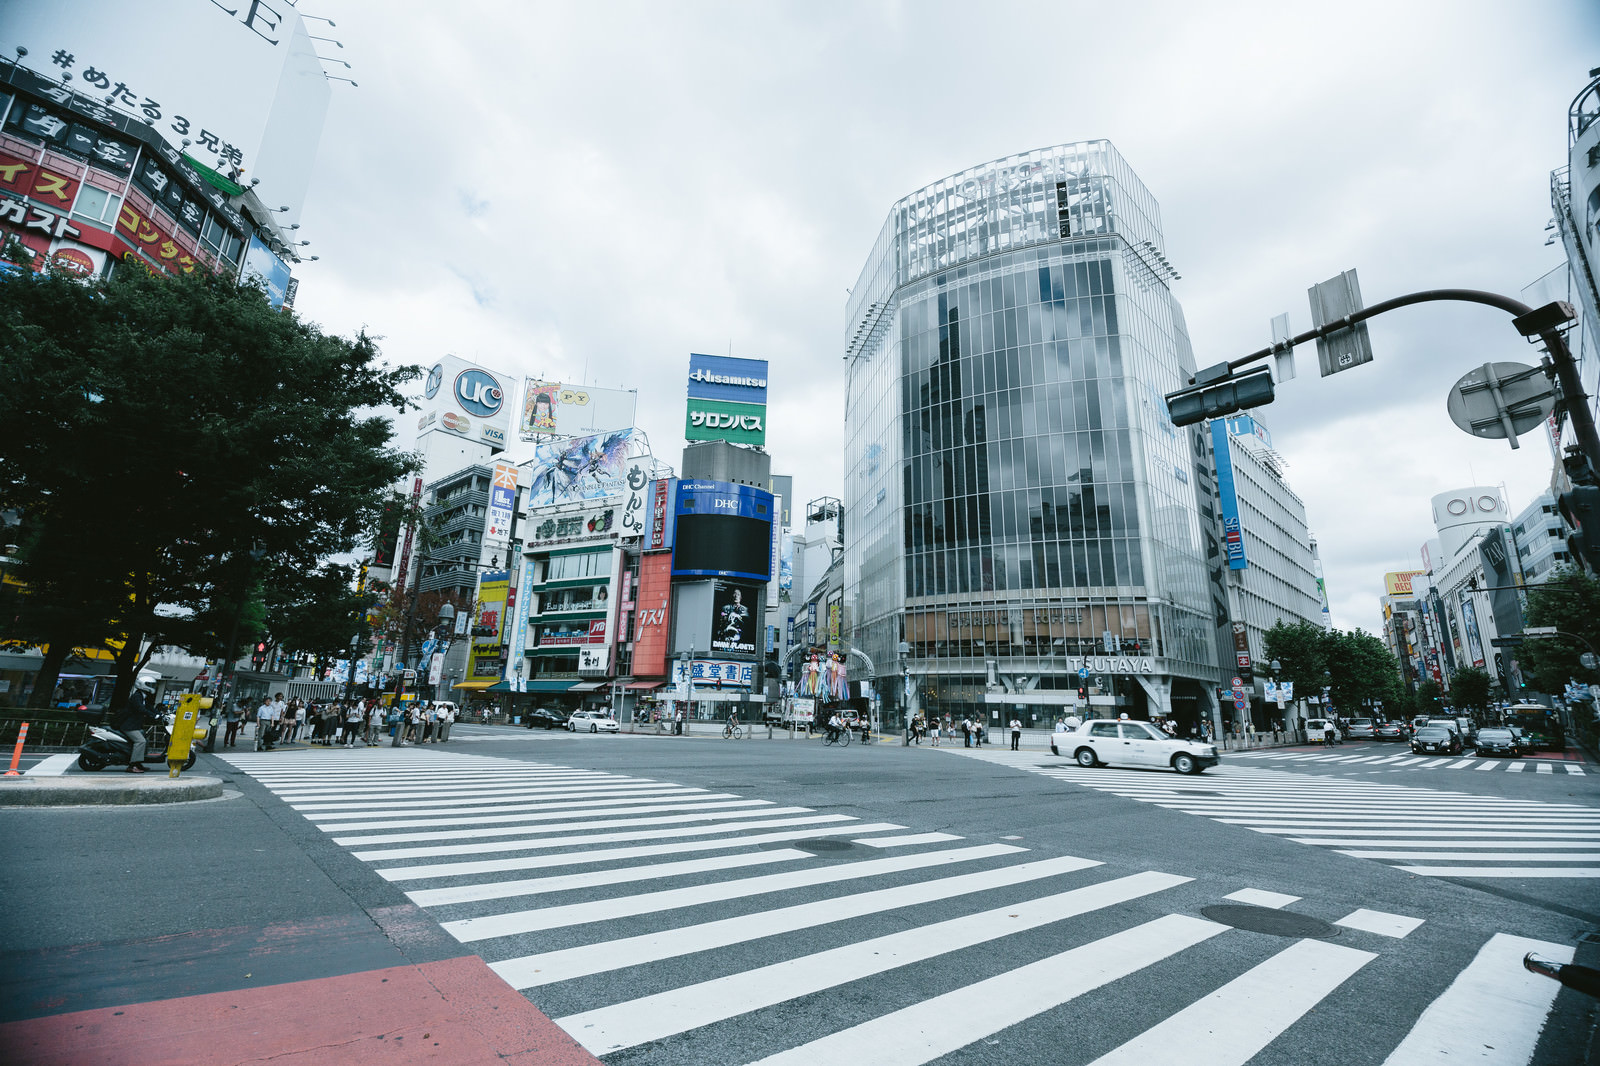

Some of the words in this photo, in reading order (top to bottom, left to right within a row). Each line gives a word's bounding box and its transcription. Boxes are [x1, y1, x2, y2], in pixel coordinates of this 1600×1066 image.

[211, 0, 283, 46] E
[0, 199, 80, 238] ガスト
[689, 368, 767, 388] Hisamitsu
[460, 376, 501, 409] UC
[689, 410, 763, 431] サロンパス
[484, 428, 504, 441] VISA
[622, 464, 648, 534] もんじゃ
[714, 499, 738, 509] DHC
[1224, 516, 1243, 560] SEIBU
[591, 622, 606, 633] JTB
[636, 600, 667, 642] クスリ
[950, 612, 1024, 628] STARBUCKS
[1032, 612, 1084, 625] COFFEE
[677, 663, 752, 681] 大盛堂書店
[1070, 657, 1152, 673] TSUTAYA
